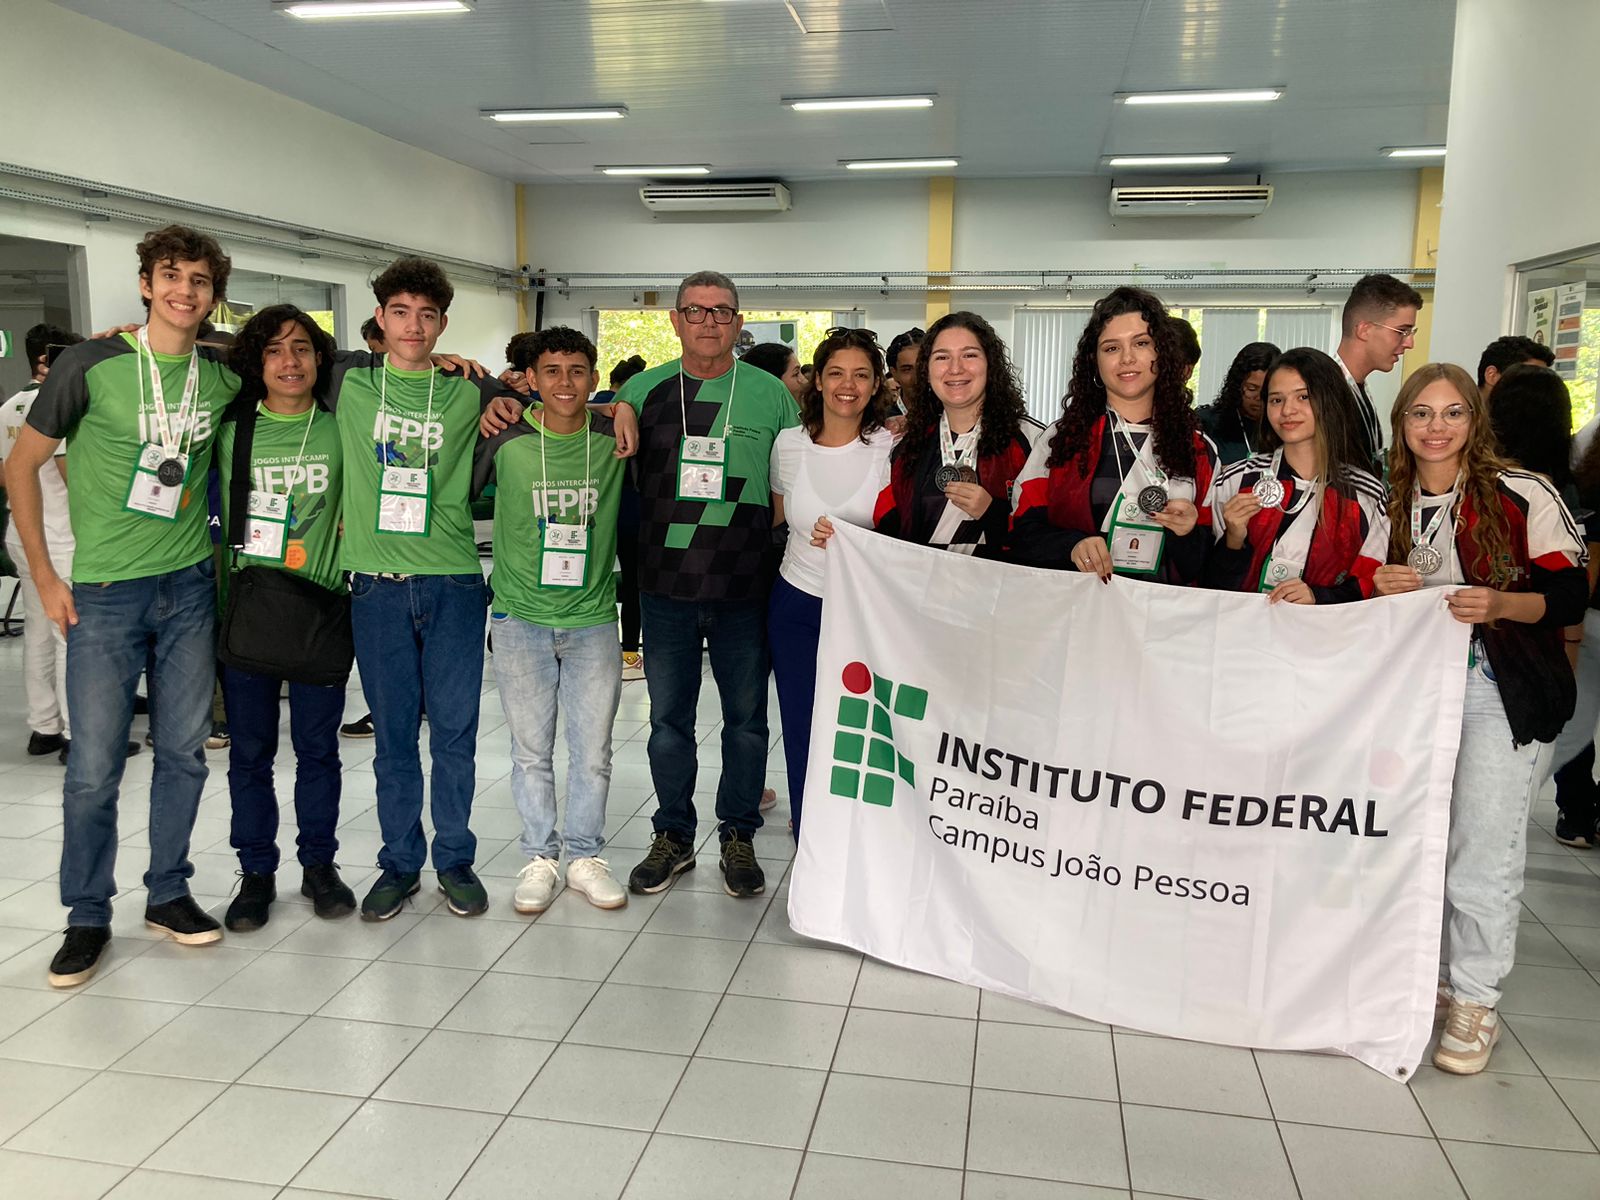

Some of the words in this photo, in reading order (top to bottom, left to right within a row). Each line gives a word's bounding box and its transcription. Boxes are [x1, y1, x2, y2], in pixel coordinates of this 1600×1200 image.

[373, 411, 444, 450] IFPB
[253, 456, 280, 465] JOGOS
[254, 464, 330, 494] IFPB
[532, 488, 600, 518] IFPB
[936, 730, 1167, 816] INSTITUTO
[1181, 790, 1390, 838] FEDERAL
[929, 776, 1040, 832] Paraíba
[928, 814, 1047, 870] Campus
[1051, 848, 1123, 888] João
[1133, 865, 1252, 907] Pessoa
